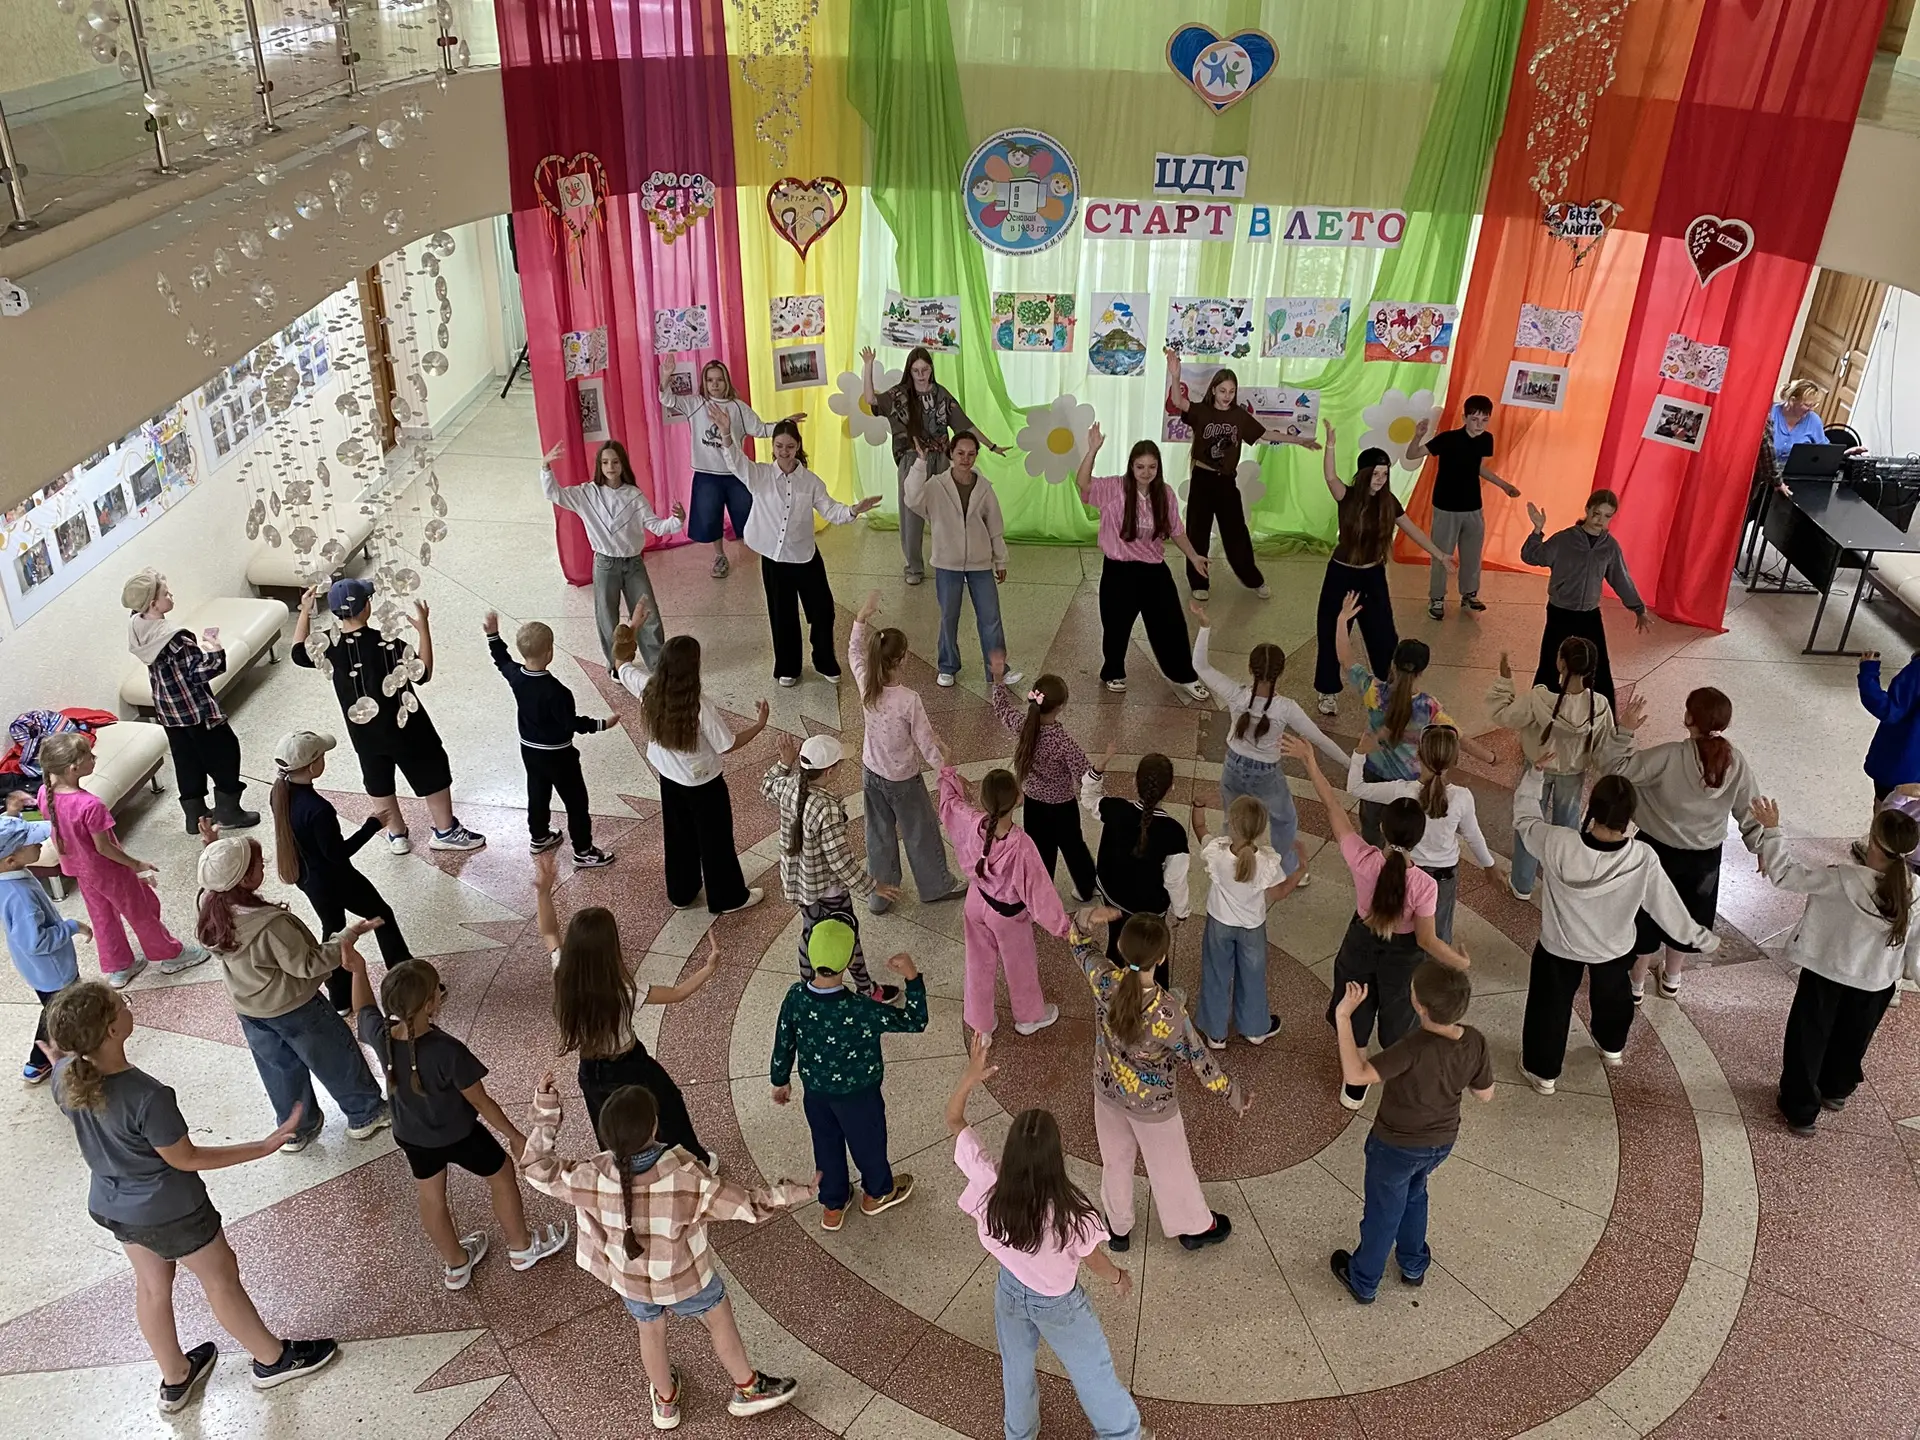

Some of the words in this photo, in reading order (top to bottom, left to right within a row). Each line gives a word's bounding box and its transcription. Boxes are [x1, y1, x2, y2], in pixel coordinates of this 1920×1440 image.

[1154, 158, 1245, 195] ЦДТ
[1006, 213, 1037, 222] Основан
[1017, 223, 1035, 232] 1983
[1085, 203, 1232, 235] СТАРТ
[1249, 207, 1271, 237] В
[1283, 210, 1407, 242] ЛЕТО
